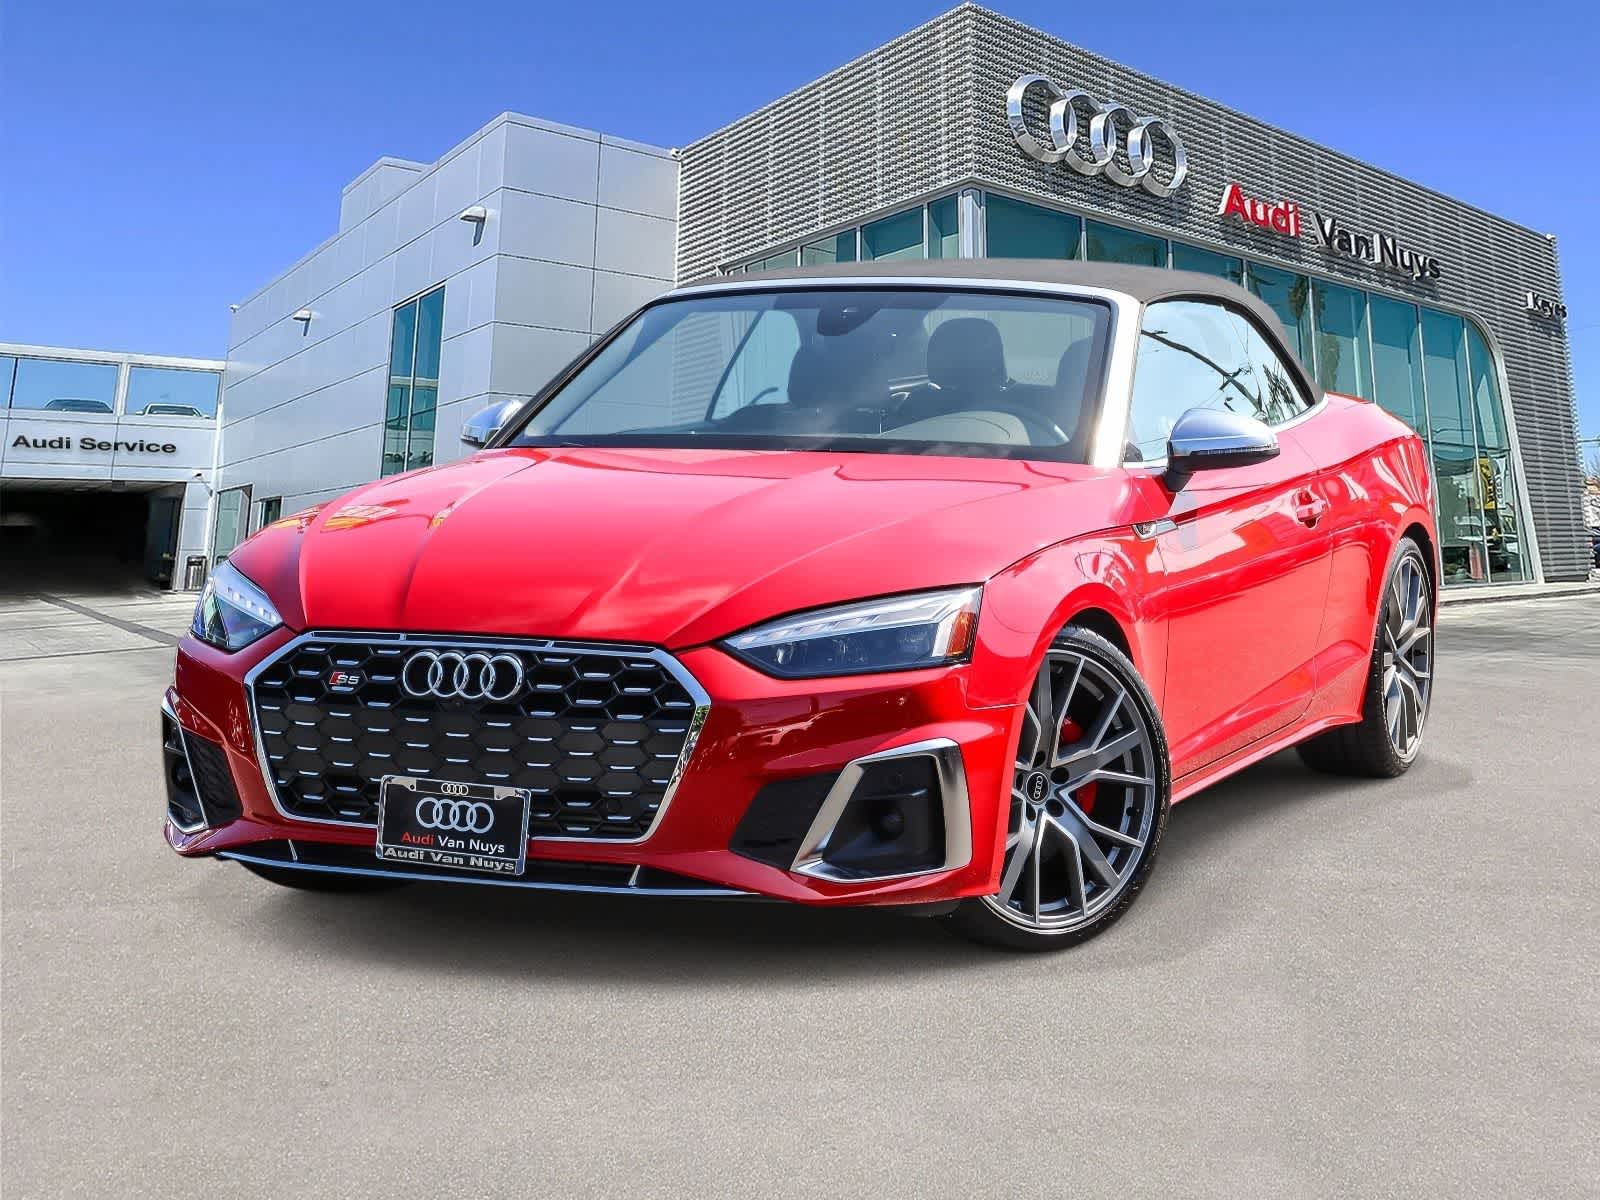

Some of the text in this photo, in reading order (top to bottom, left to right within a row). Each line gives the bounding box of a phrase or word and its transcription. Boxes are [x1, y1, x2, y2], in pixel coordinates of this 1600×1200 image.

[1218, 183, 1441, 280] Audi Van Nuys
[12, 435, 177, 453] Audi Service
[336, 674, 361, 685] S5
[401, 831, 505, 855] Audi Van Nuys
[384, 847, 515, 871] Audi Van Nuys
